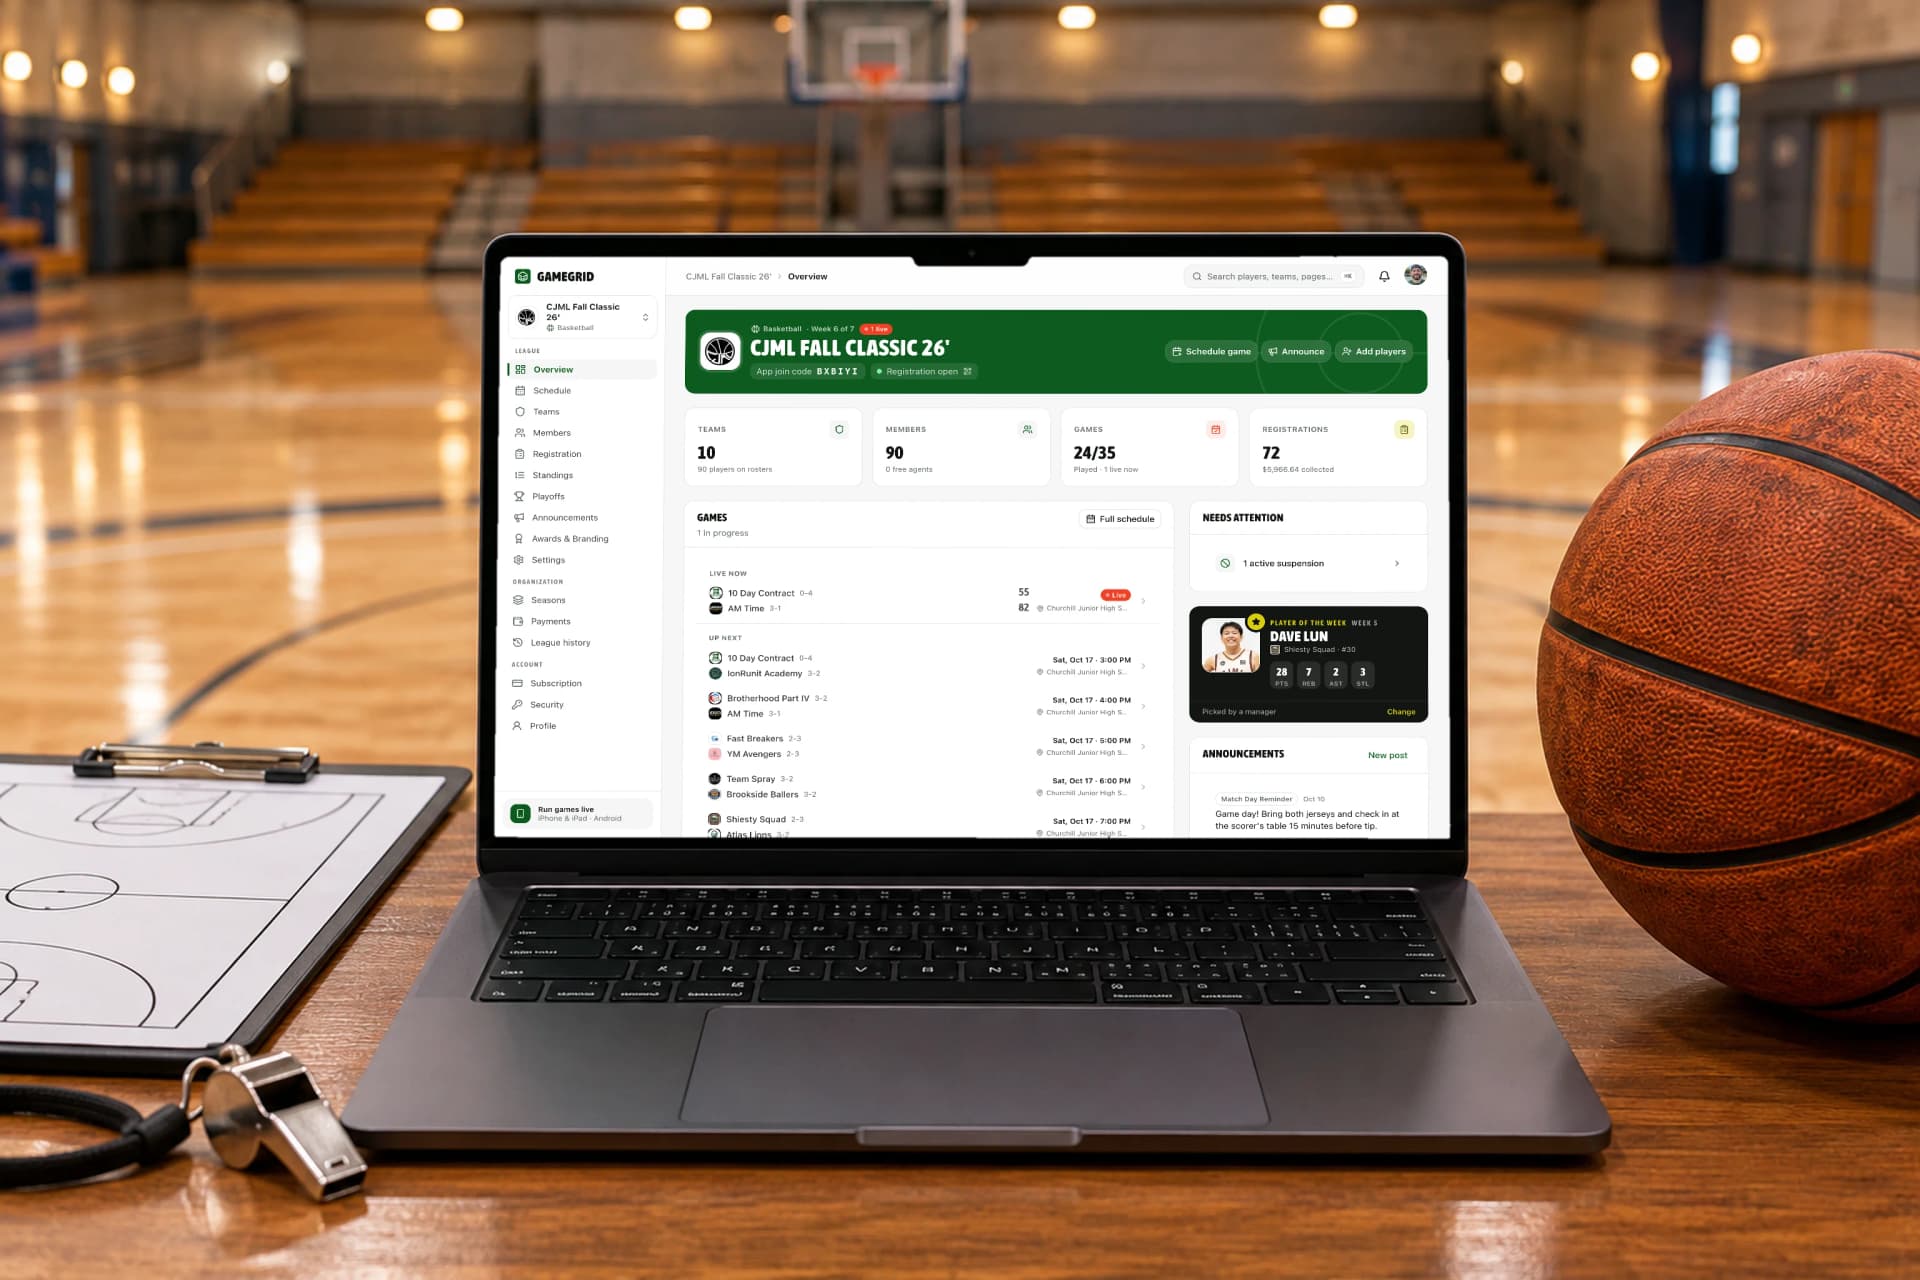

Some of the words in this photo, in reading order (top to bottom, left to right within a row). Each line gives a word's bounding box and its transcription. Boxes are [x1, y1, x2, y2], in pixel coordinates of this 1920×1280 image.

[537, 272, 594, 282] GAMEGRID
[1238, 273, 1269, 282] players,
[764, 324, 802, 332] Basketball
[751, 340, 796, 356] CJML
[800, 339, 841, 356] FALL
[846, 339, 918, 356] CLASSIC
[922, 340, 950, 356] 26'
[1375, 348, 1406, 356] players
[757, 368, 773, 376] App
[775, 368, 790, 376] join
[887, 368, 936, 376] Registration
[534, 408, 560, 416] Teams
[533, 450, 582, 459] Registration
[698, 446, 715, 459] 10
[886, 446, 904, 459] 90
[1074, 446, 1116, 461] 24/35
[1263, 446, 1280, 459] 72
[709, 466, 734, 474] players
[533, 472, 574, 480] Standings
[533, 493, 565, 502] Playoffs
[532, 514, 598, 522] Announcements
[697, 514, 727, 522] GAMES
[1117, 515, 1155, 523] schedule
[1202, 514, 1232, 522] NEEDS
[1234, 514, 1284, 522] ATTENTION
[573, 535, 609, 544] Branding
[532, 556, 566, 565] Settings
[1277, 560, 1324, 568] suspension
[740, 590, 756, 598] Day
[1019, 588, 1030, 596] 55
[532, 596, 566, 604] Seasons
[1018, 603, 1029, 612] 82
[532, 618, 571, 626] Payments
[1271, 630, 1301, 642] DAVE
[1304, 630, 1328, 642] LUN
[531, 640, 560, 648] League
[563, 639, 591, 648] history
[764, 670, 802, 679] Academy
[1276, 668, 1287, 676] 28
[1306, 668, 1312, 676] 7
[1333, 668, 1339, 676] 2
[1360, 668, 1366, 676] 3
[531, 680, 582, 688] Subscription
[530, 701, 564, 710] Security
[1202, 708, 1226, 716] Picked
[1227, 708, 1237, 716] by
[1387, 708, 1416, 716] Change
[530, 722, 556, 730] Profile
[727, 750, 740, 758] YM
[743, 750, 782, 759] Avengers
[1203, 750, 1284, 758] ANNOUNCEMENTS
[1389, 752, 1408, 760] post
[752, 776, 776, 784] Spray
[1216, 810, 1240, 818] Game
[1242, 810, 1259, 819] day!
[1262, 810, 1283, 819] Bring
[1285, 810, 1304, 818] both
[1306, 810, 1335, 819] jerseys
[1338, 810, 1352, 818] and
[1355, 810, 1380, 818] check
[726, 816, 757, 824] Shiesty
[760, 816, 786, 824] Squad
[1216, 822, 1229, 830] the
[1266, 822, 1287, 830] table
[1301, 822, 1334, 830] minutes
[1336, 822, 1362, 830] before
[1364, 822, 1377, 831] tip.
